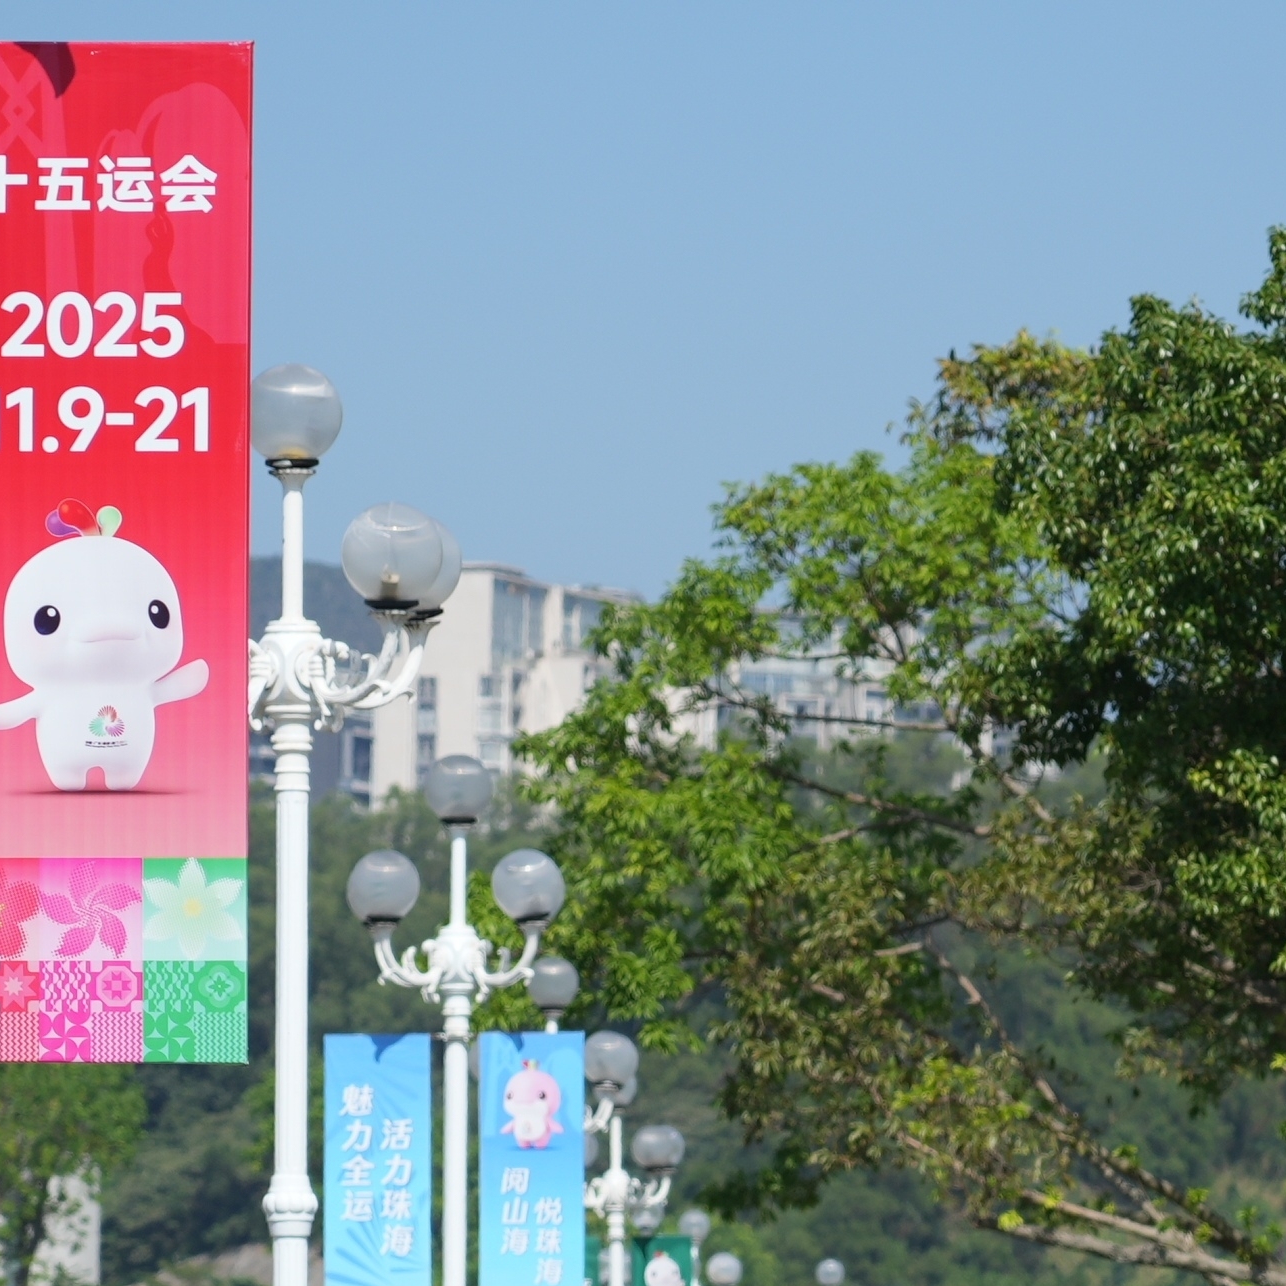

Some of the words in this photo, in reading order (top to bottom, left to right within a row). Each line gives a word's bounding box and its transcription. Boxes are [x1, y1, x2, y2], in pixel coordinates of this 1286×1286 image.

[0, 290, 185, 359] 2025
[339, 1084, 376, 1222] 魅力全运
[380, 1117, 414, 1257] 活力珠海
[533, 1196, 564, 1286] 悦珠海
